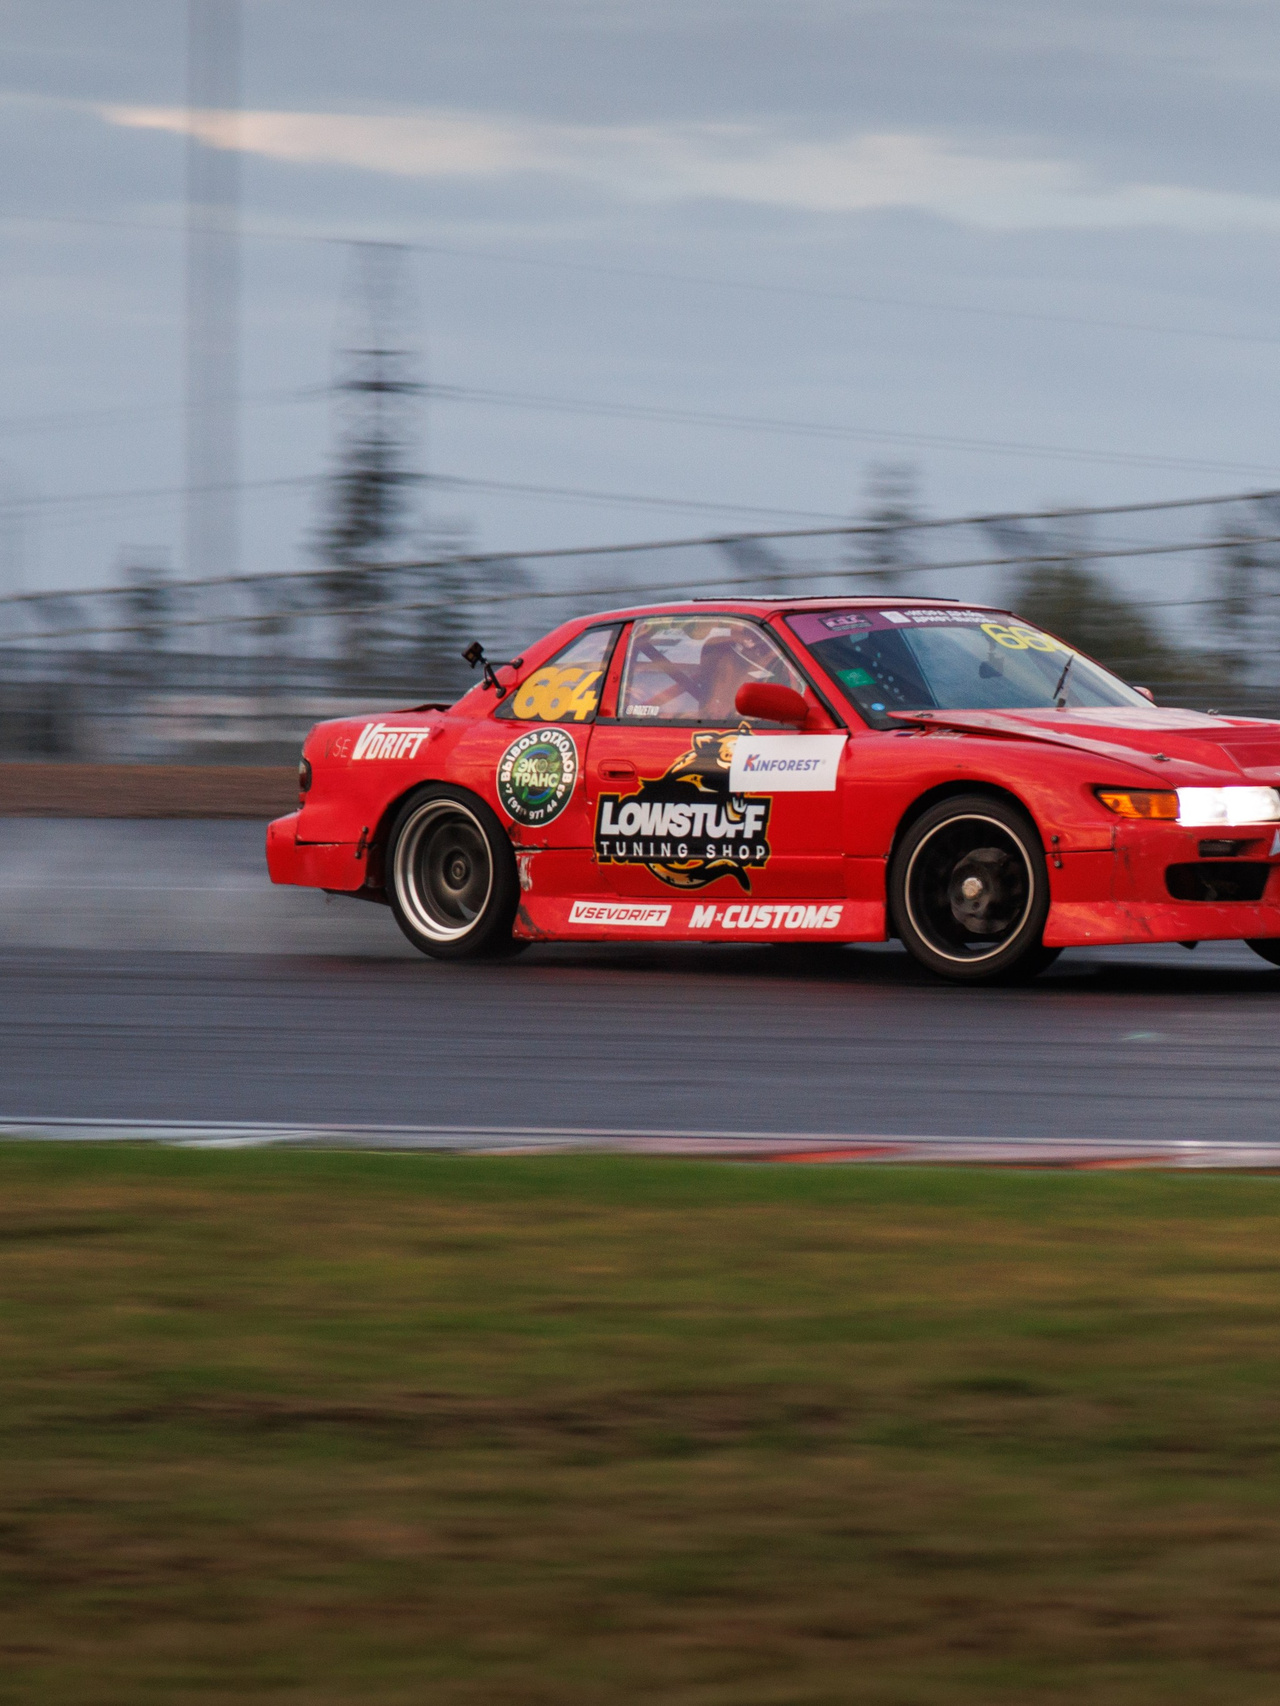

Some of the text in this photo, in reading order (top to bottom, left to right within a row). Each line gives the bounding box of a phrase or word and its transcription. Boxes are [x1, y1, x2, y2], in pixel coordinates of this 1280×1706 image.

[513, 667, 602, 721] 664
[351, 723, 430, 760] VDRIFT
[500, 731, 575, 783] ВЫВОЗ ОТХОДОВ
[743, 754, 821, 772] KINFOREST
[514, 772, 561, 788] ТРАНС
[600, 841, 766, 860] TUNING SHOP
[574, 906, 667, 922] VSEVDRIFT
